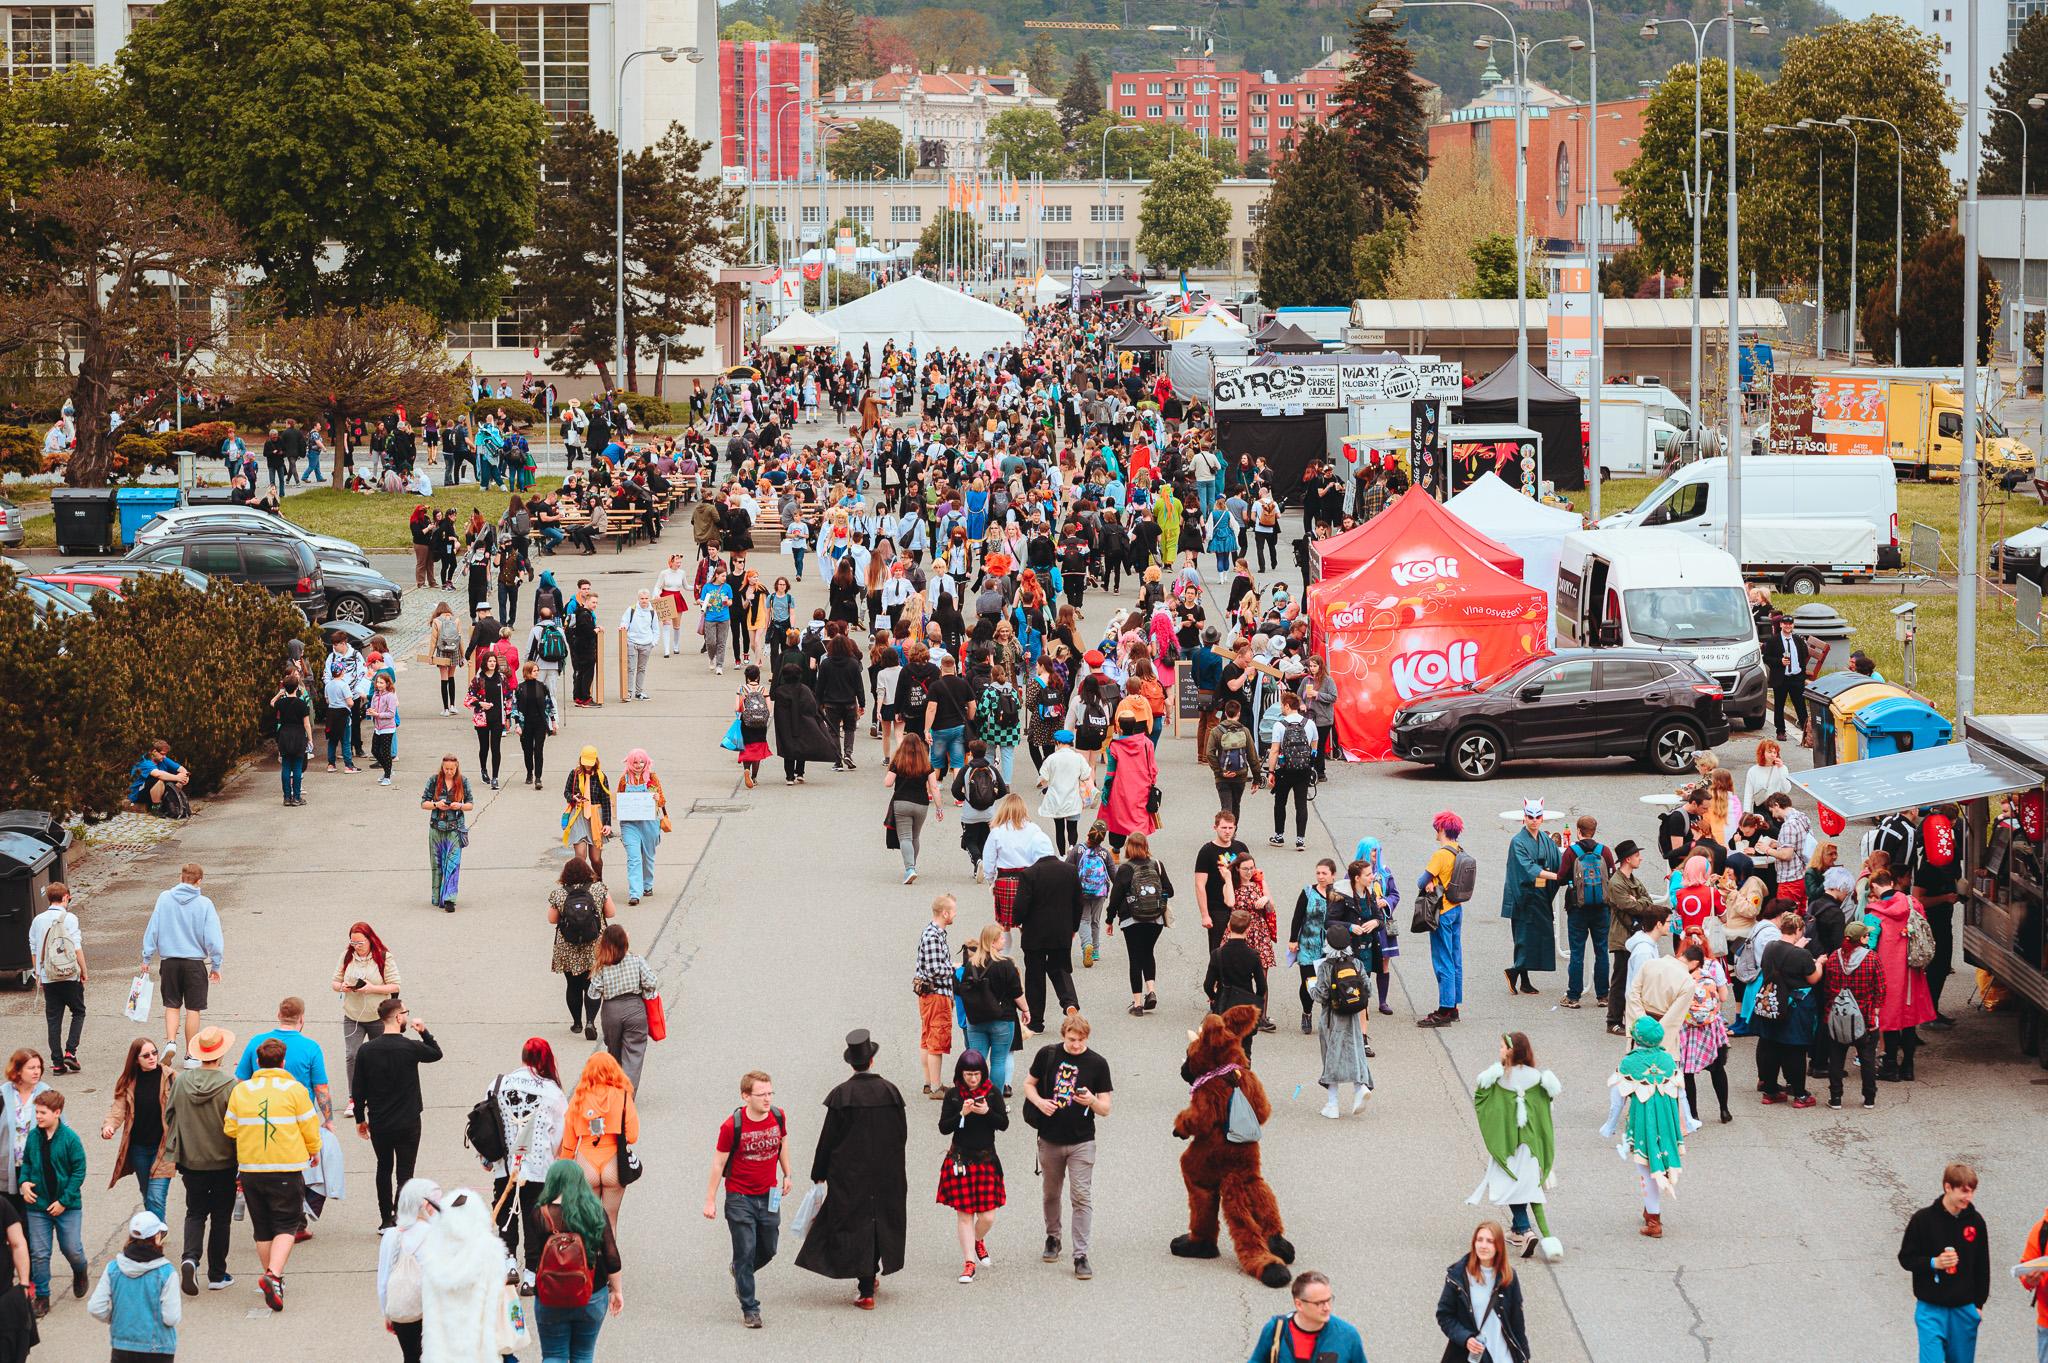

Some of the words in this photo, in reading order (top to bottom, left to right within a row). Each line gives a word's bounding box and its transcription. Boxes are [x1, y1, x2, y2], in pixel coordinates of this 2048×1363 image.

[1342, 367, 1379, 379] MAXI
[1215, 365, 1306, 402] GYROS
[1431, 375, 1459, 386] PIVU
[1308, 387, 1336, 396] NUDLE
[1386, 380, 1416, 395] GRILL
[1796, 440, 1838, 453] BASQUE
[1088, 714, 1107, 726] VANS
[1852, 771, 1905, 798] LITTLE
